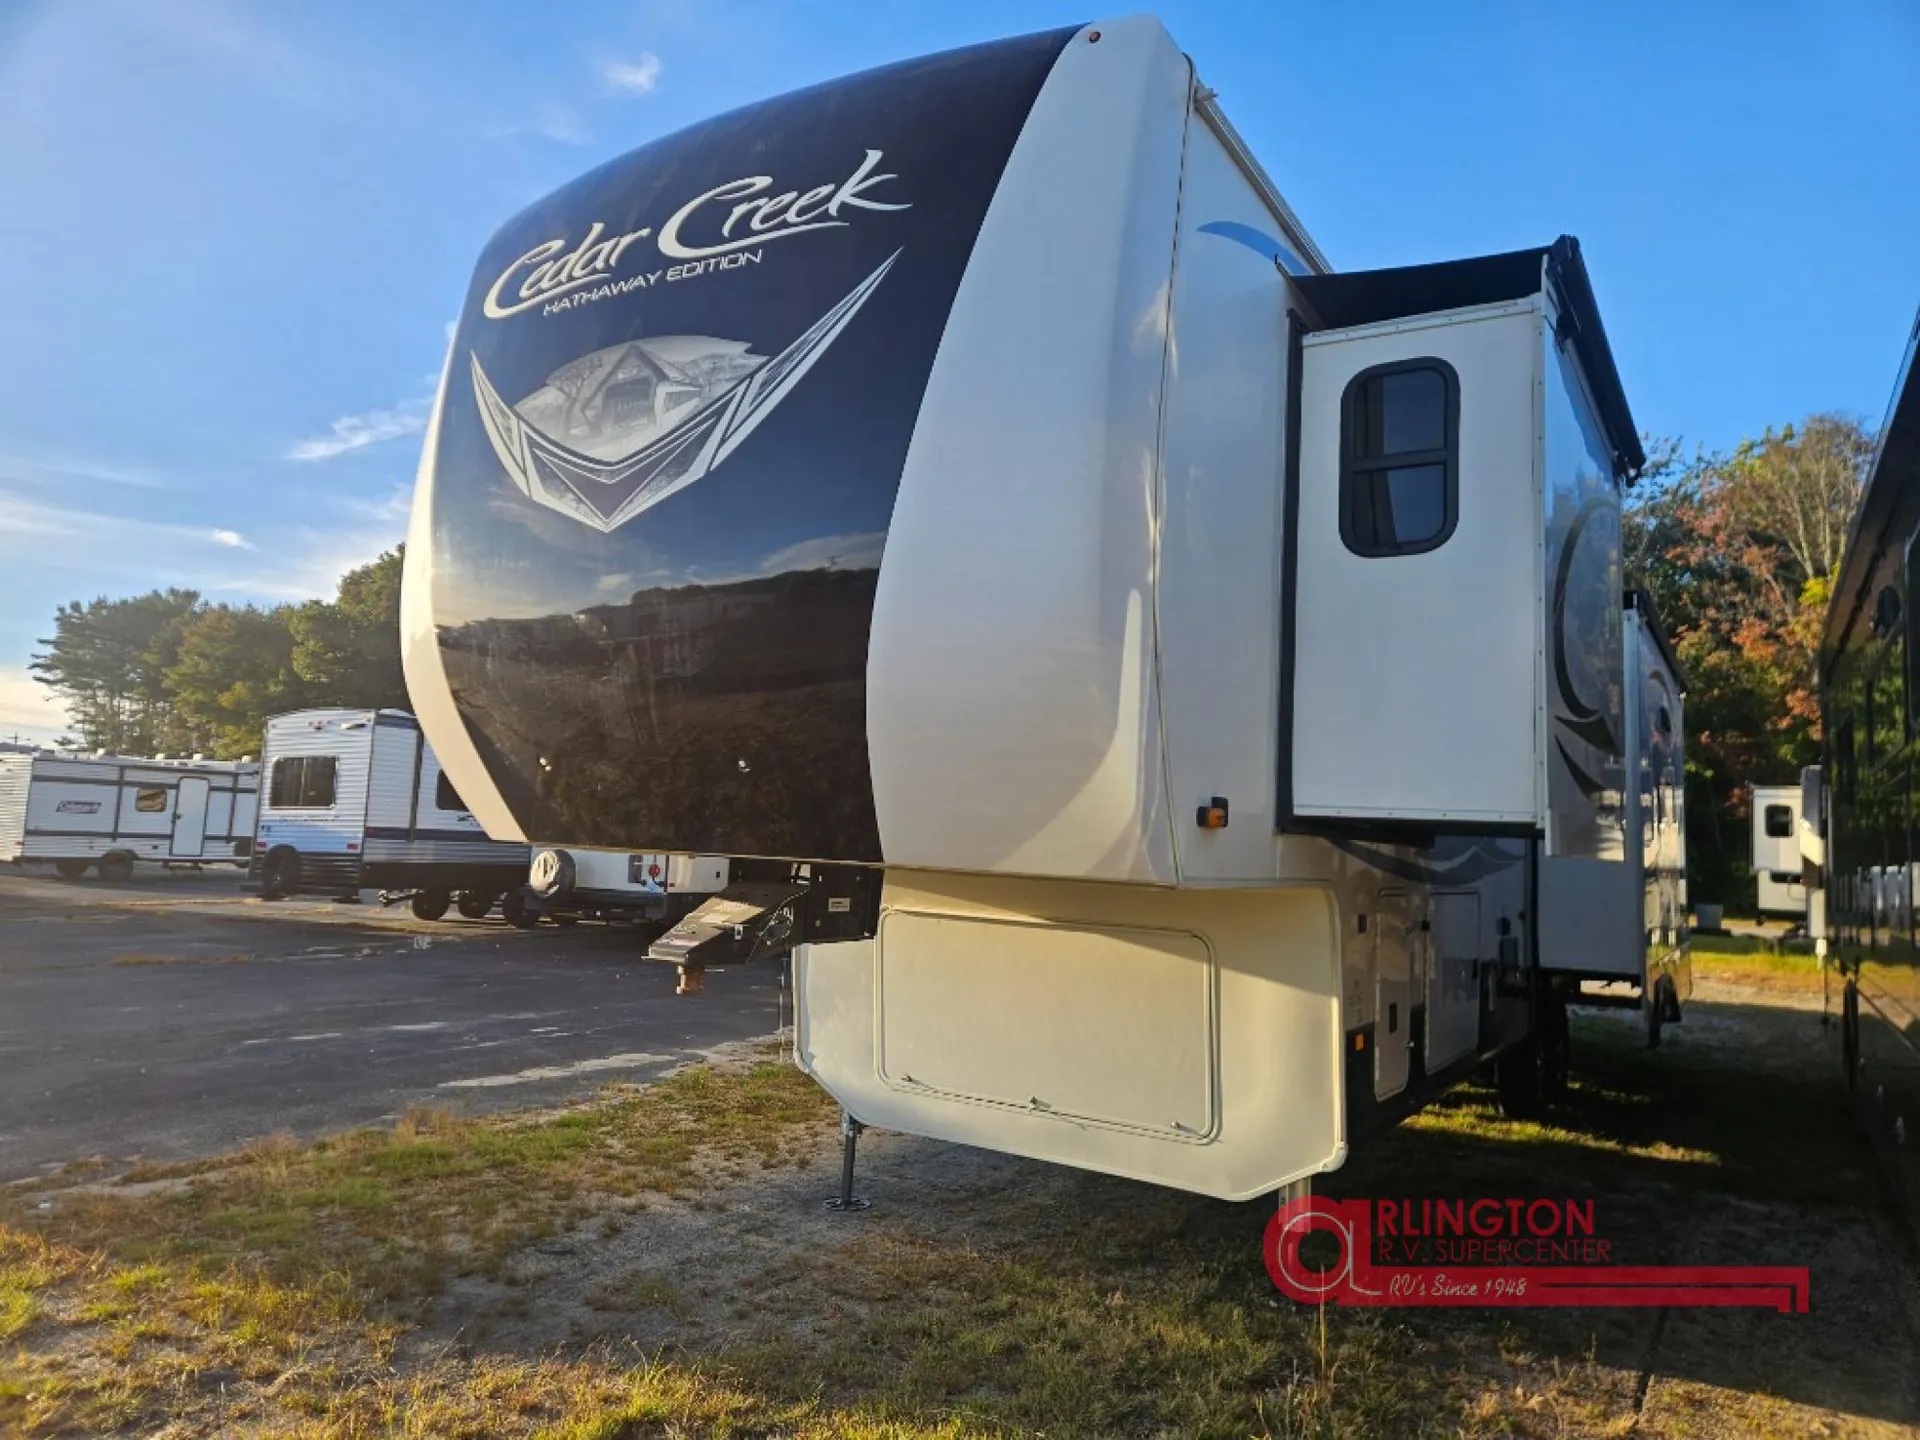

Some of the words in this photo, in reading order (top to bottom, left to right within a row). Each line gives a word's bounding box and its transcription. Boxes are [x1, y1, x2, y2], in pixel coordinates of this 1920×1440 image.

[483, 222, 651, 319] Cedar
[658, 149, 913, 258] Creek
[543, 269, 663, 316] HATHAWAY
[666, 249, 762, 282] EDITION
